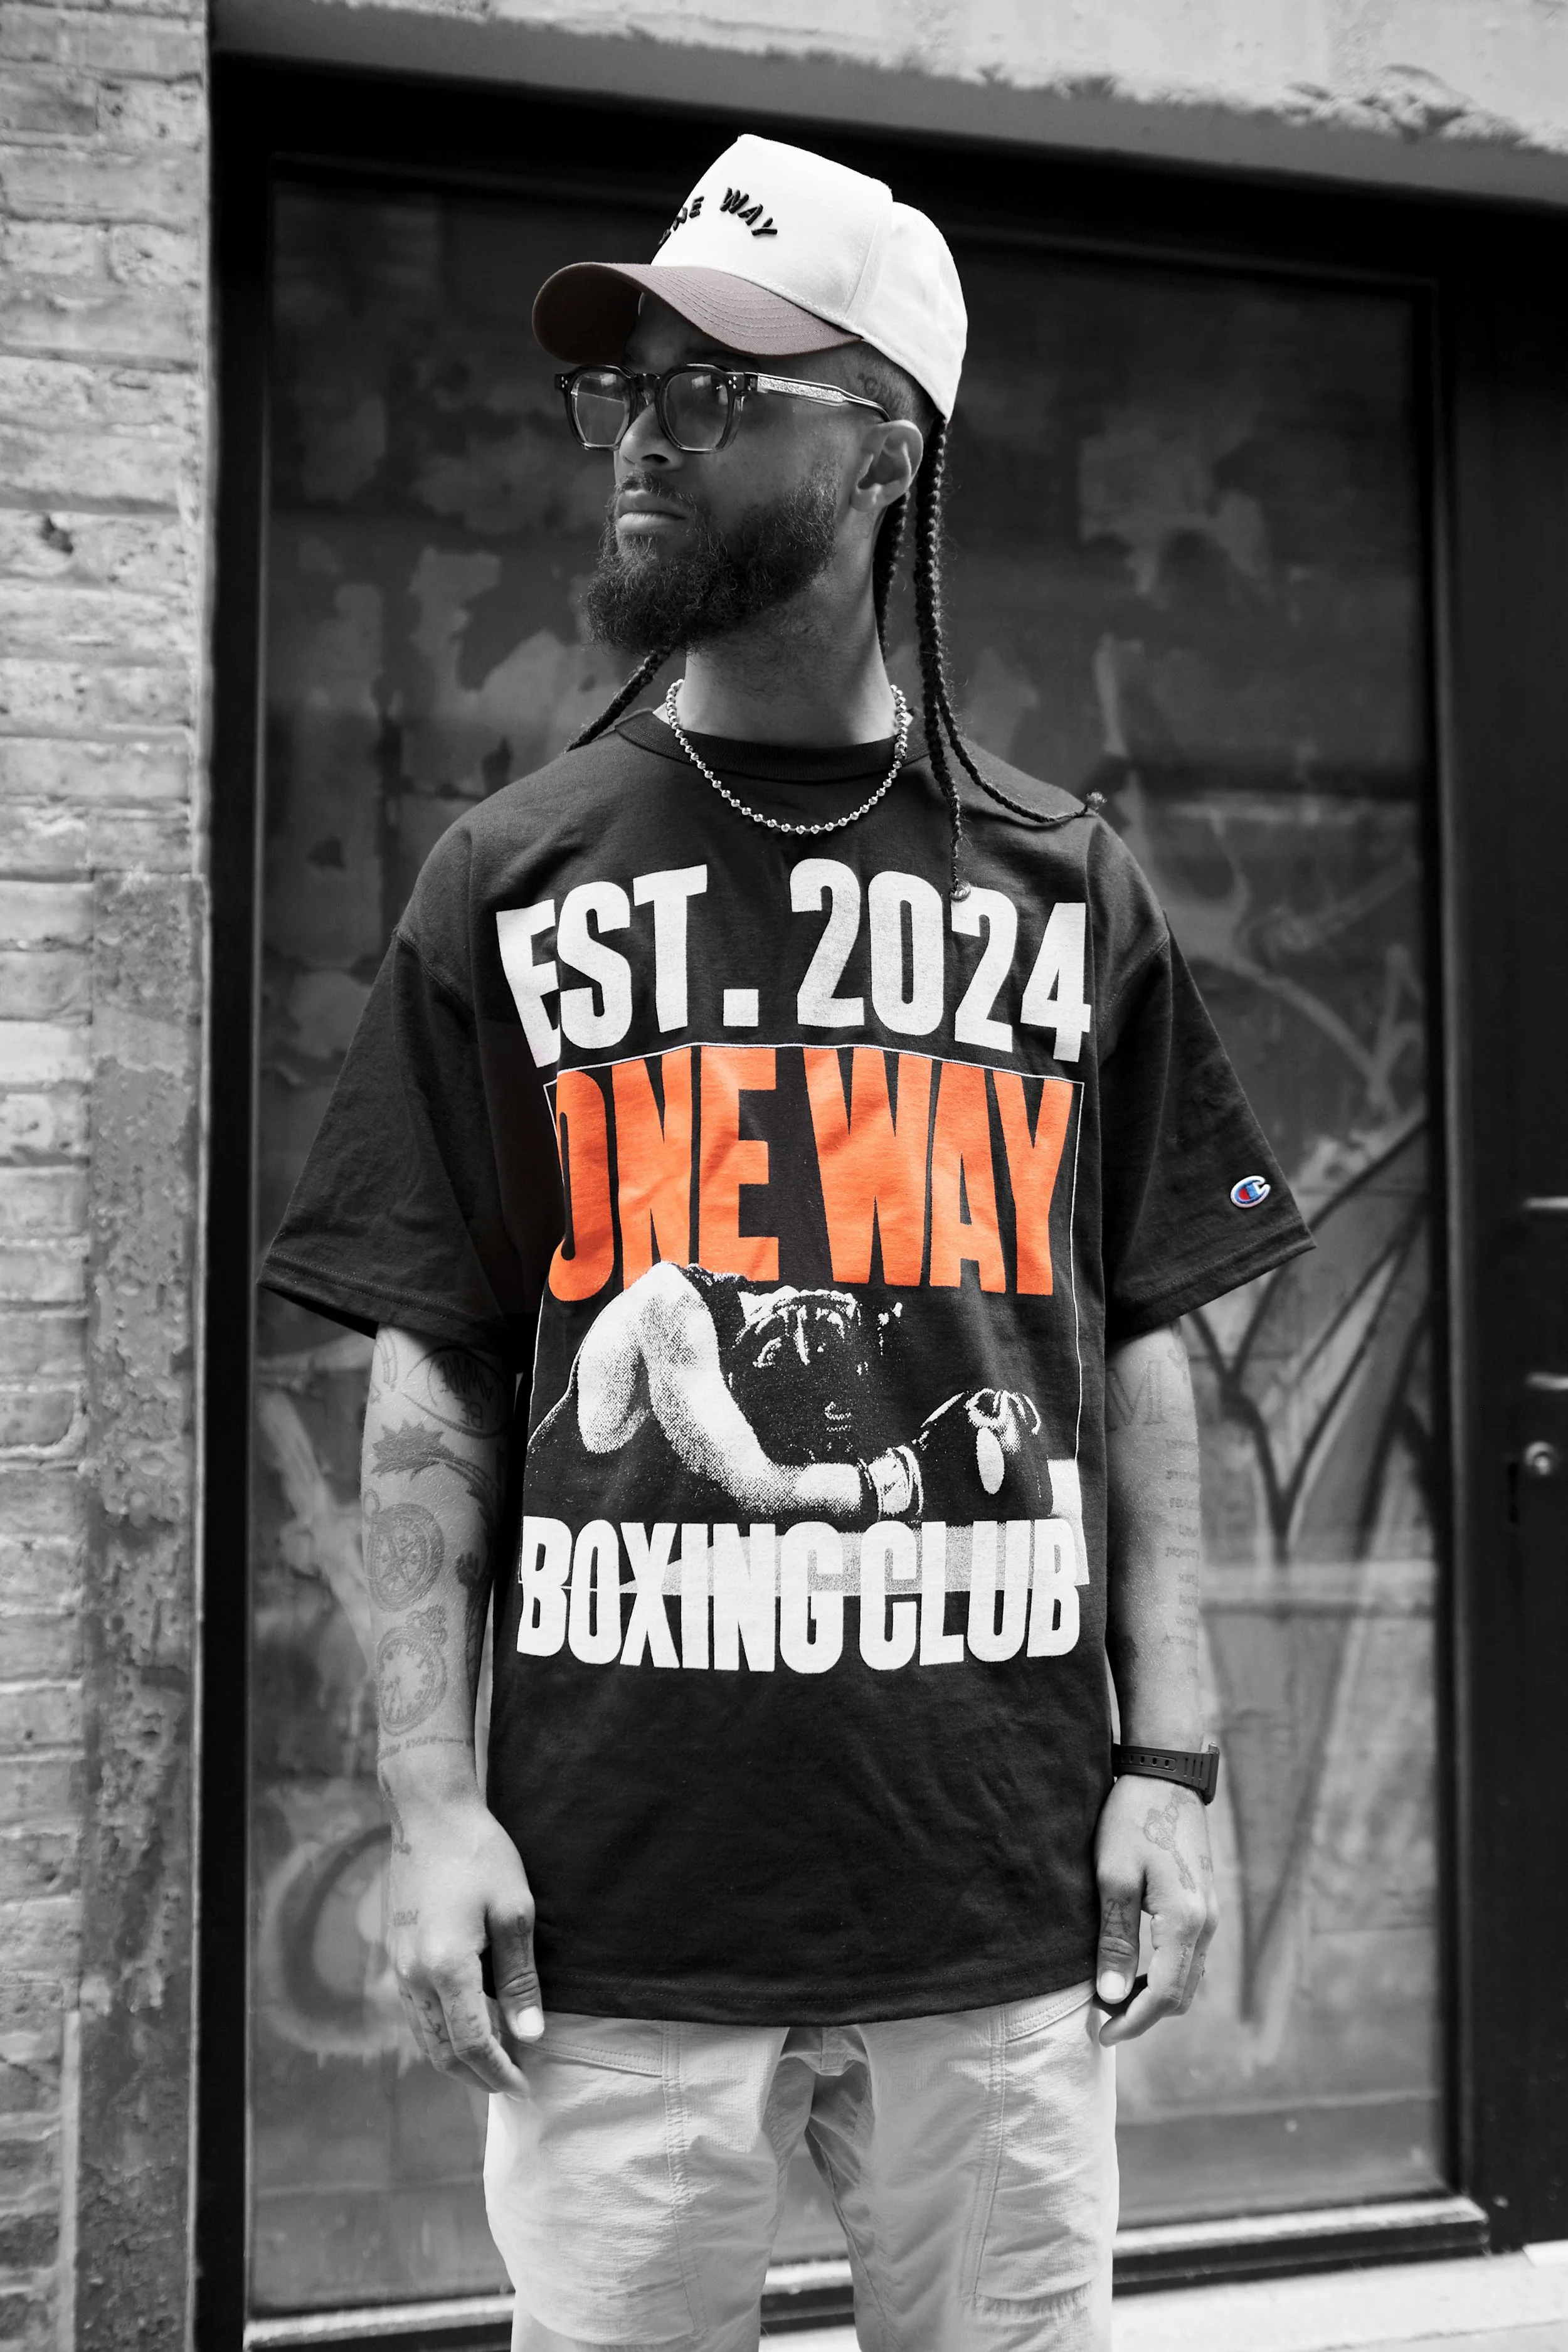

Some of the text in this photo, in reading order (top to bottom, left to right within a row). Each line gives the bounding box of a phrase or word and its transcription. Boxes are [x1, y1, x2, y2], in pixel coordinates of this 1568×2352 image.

[719, 187, 778, 236] WAY
[496, 857, 1090, 1067] EST. 2024
[548, 1046, 1073, 1301] ONE WAY
[516, 1515, 1081, 1674] BOXING CLUB
